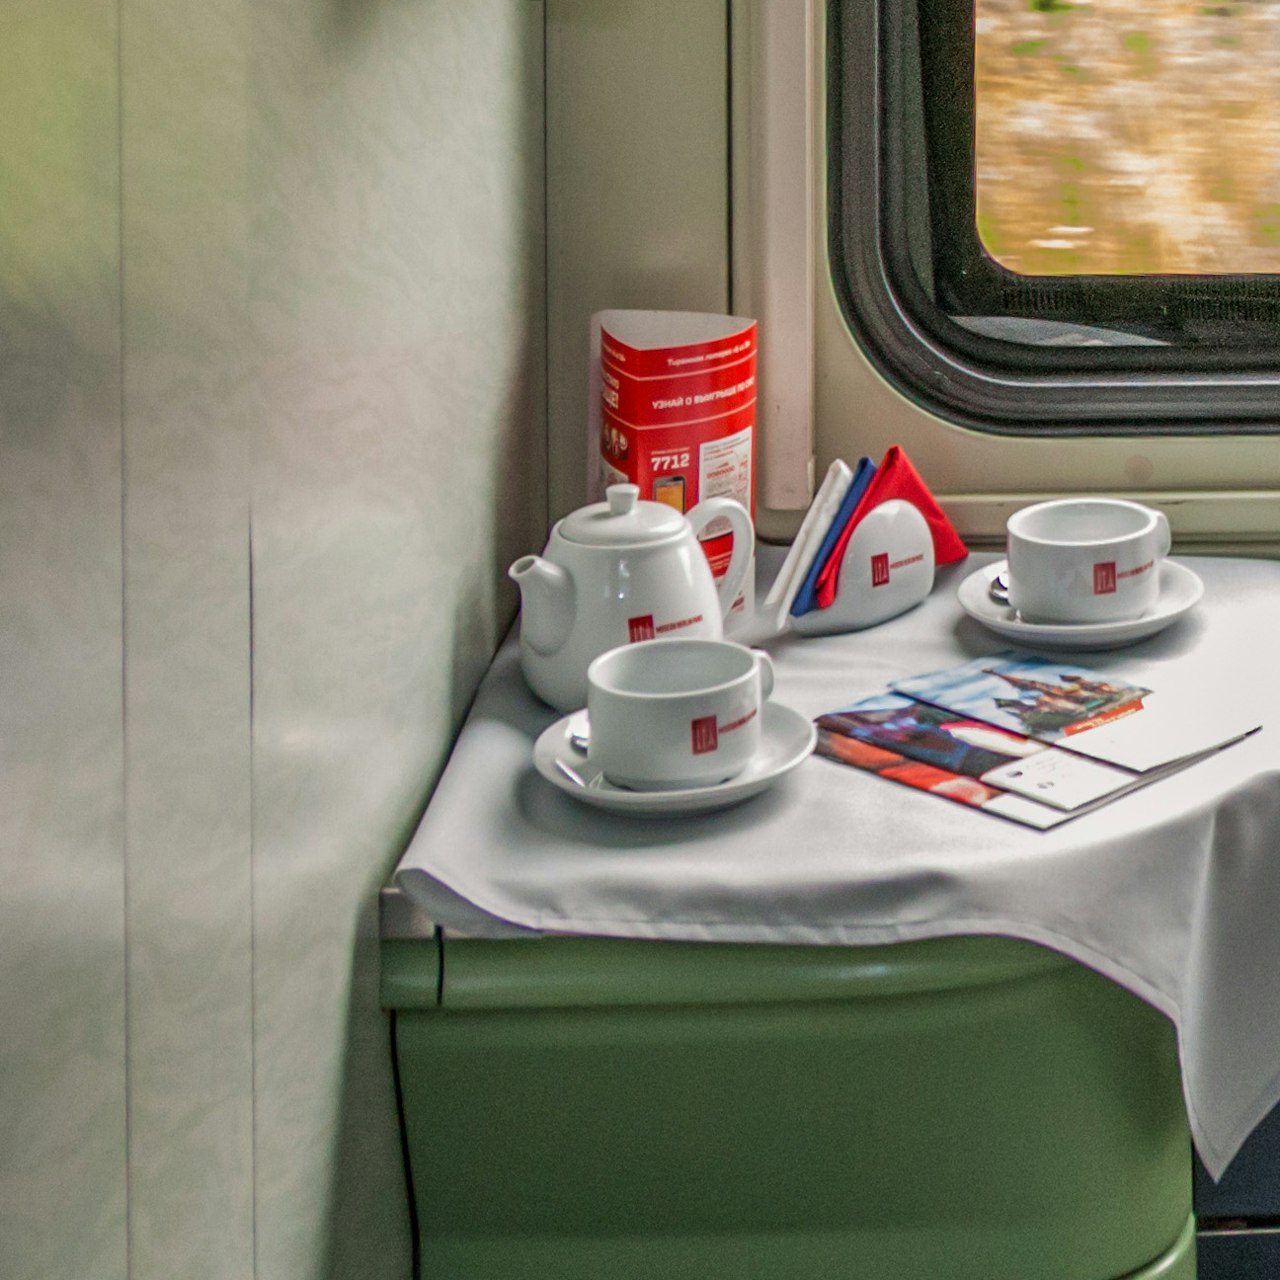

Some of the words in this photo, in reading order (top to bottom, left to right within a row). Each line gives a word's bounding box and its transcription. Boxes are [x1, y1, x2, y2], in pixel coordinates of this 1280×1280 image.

[652, 396, 684, 410] УЗНАЙ
[685, 396, 692, 405] О
[651, 453, 690, 472] 7712
